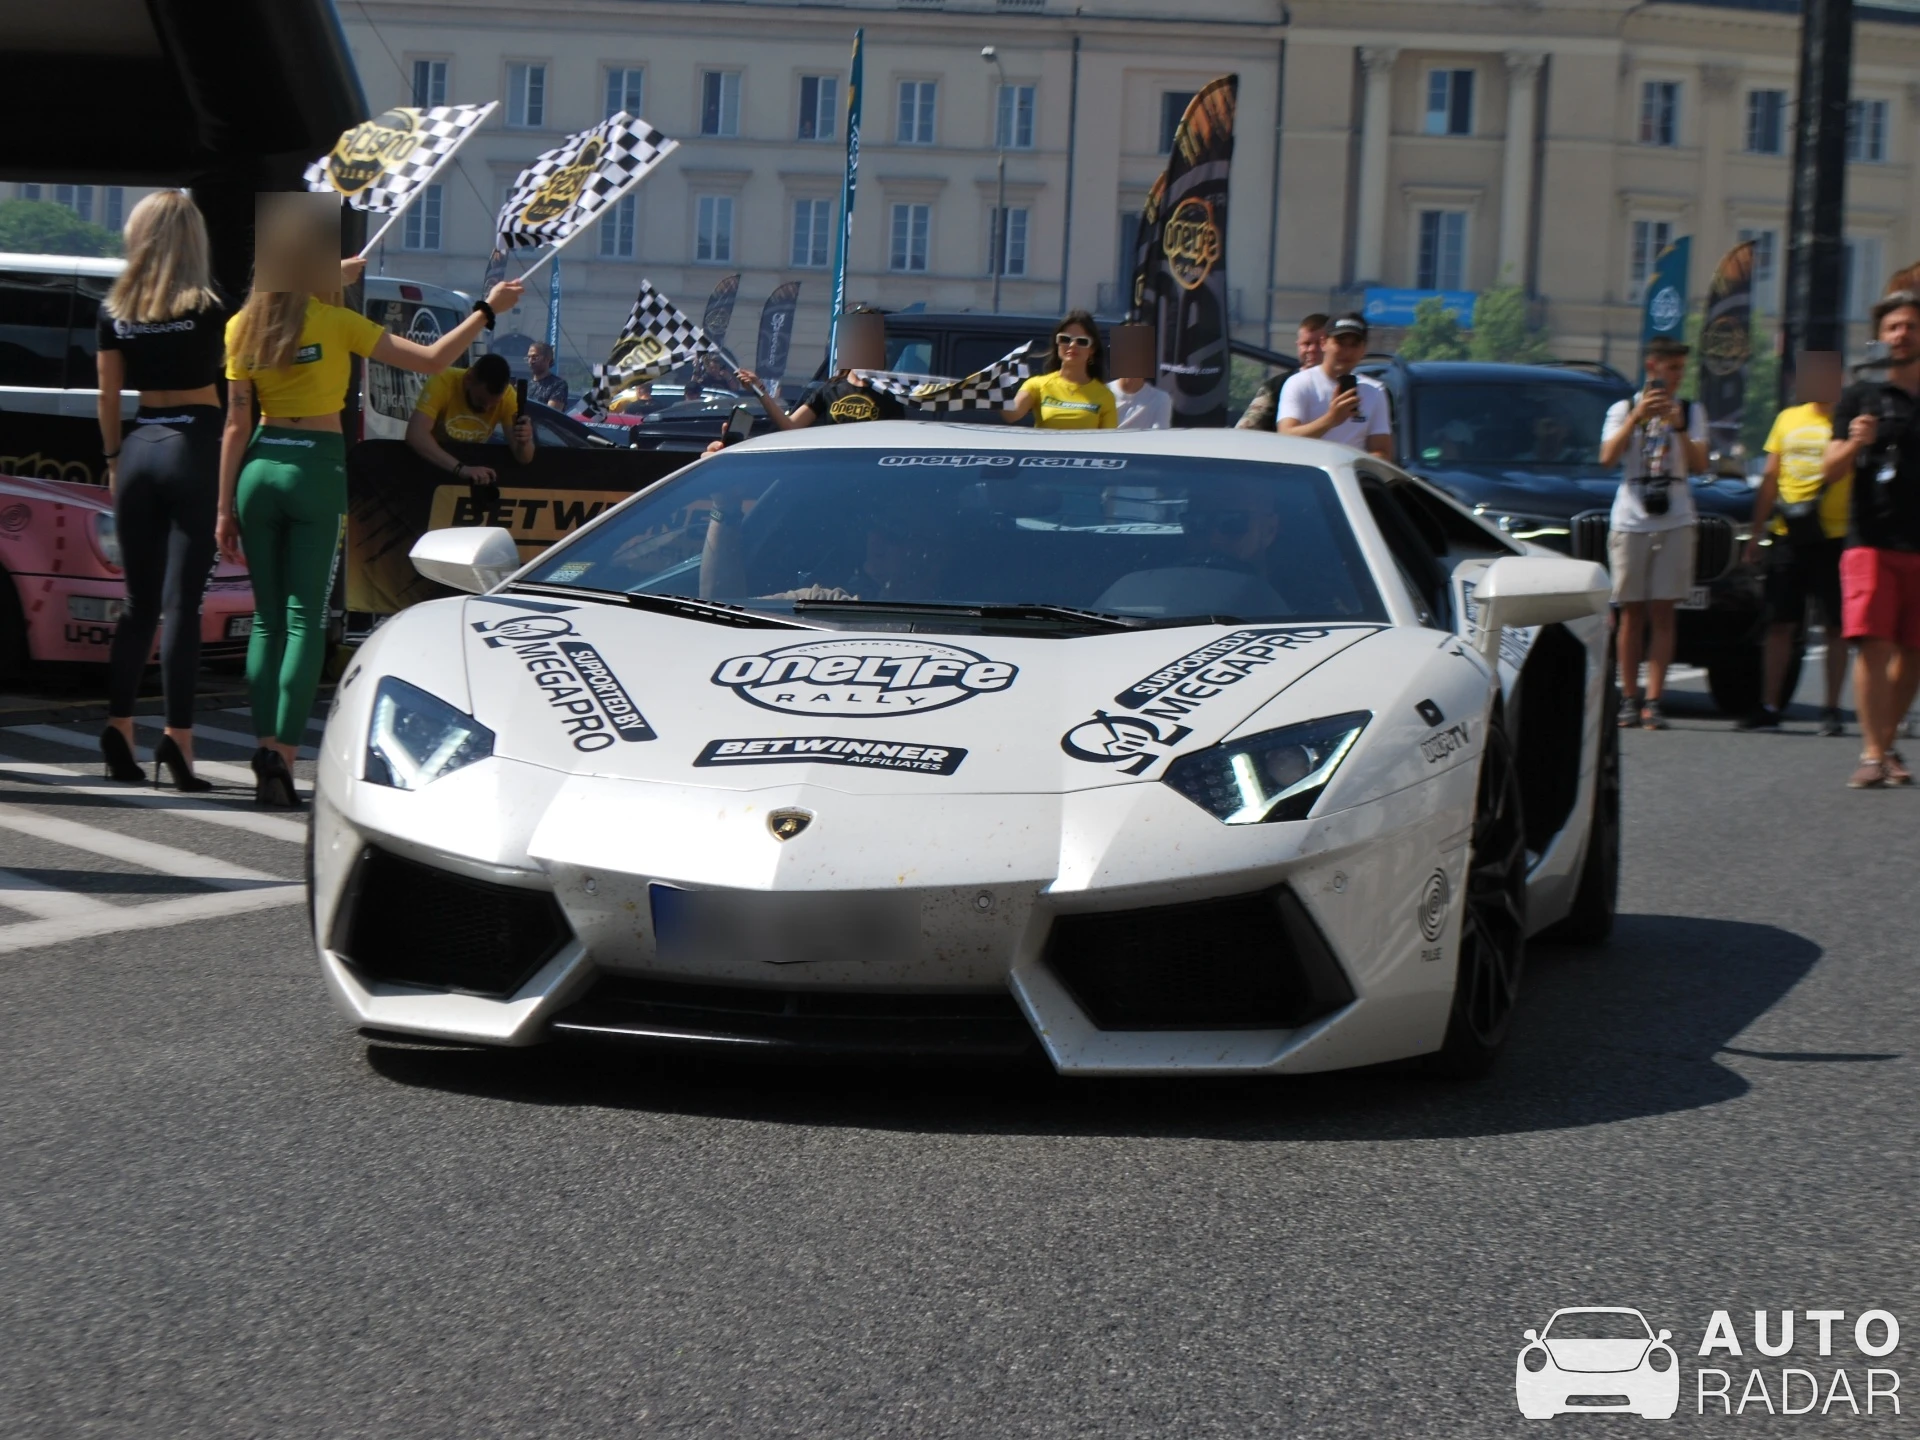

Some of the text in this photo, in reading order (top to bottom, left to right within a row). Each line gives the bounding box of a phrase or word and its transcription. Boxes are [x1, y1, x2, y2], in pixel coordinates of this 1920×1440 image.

[1133, 637, 1246, 695] SUPPORTED
[511, 641, 616, 753] MEGAPRO
[569, 649, 646, 730] SUPPORTED BY
[775, 693, 927, 706] RALLY
[715, 739, 949, 763] BETWINNER
[847, 755, 942, 772] AFFILIATES
